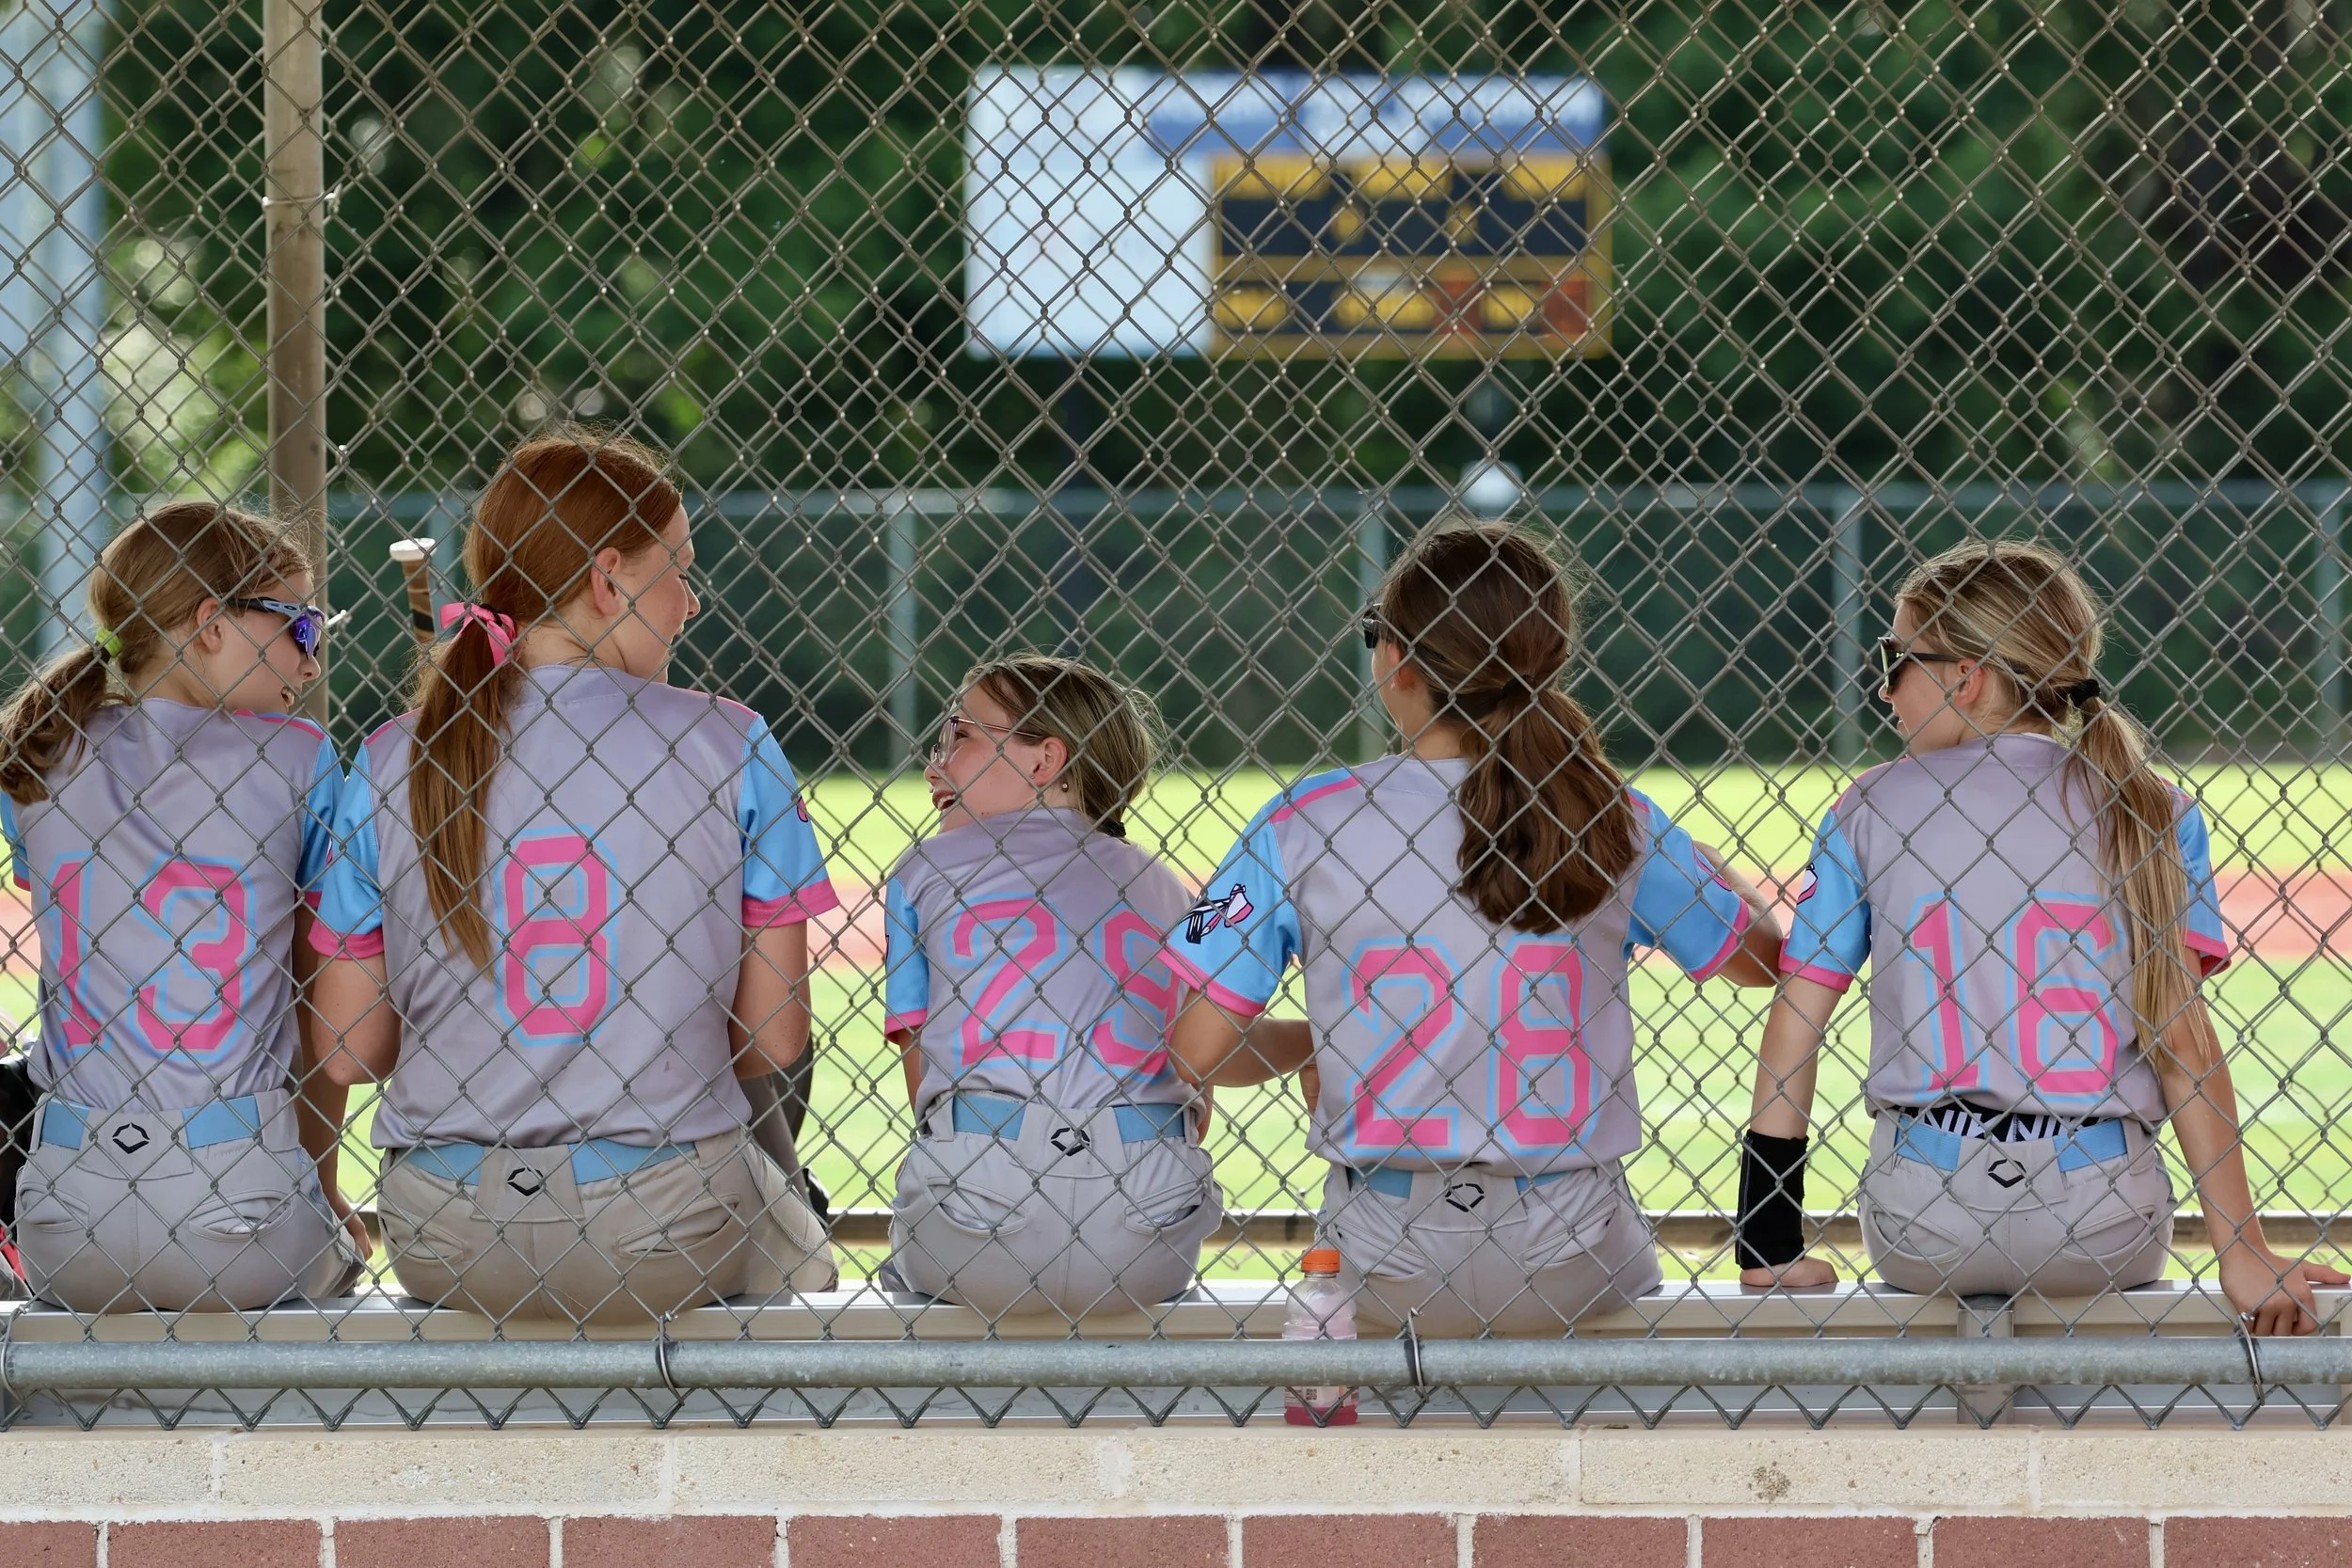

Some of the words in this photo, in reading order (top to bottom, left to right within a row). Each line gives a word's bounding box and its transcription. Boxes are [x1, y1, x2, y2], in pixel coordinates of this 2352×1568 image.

[44, 850, 256, 1061] 13
[492, 824, 618, 1047] 8
[943, 892, 1182, 1084] 29
[1905, 890, 2124, 1103] 16
[1340, 929, 1602, 1157] 28
